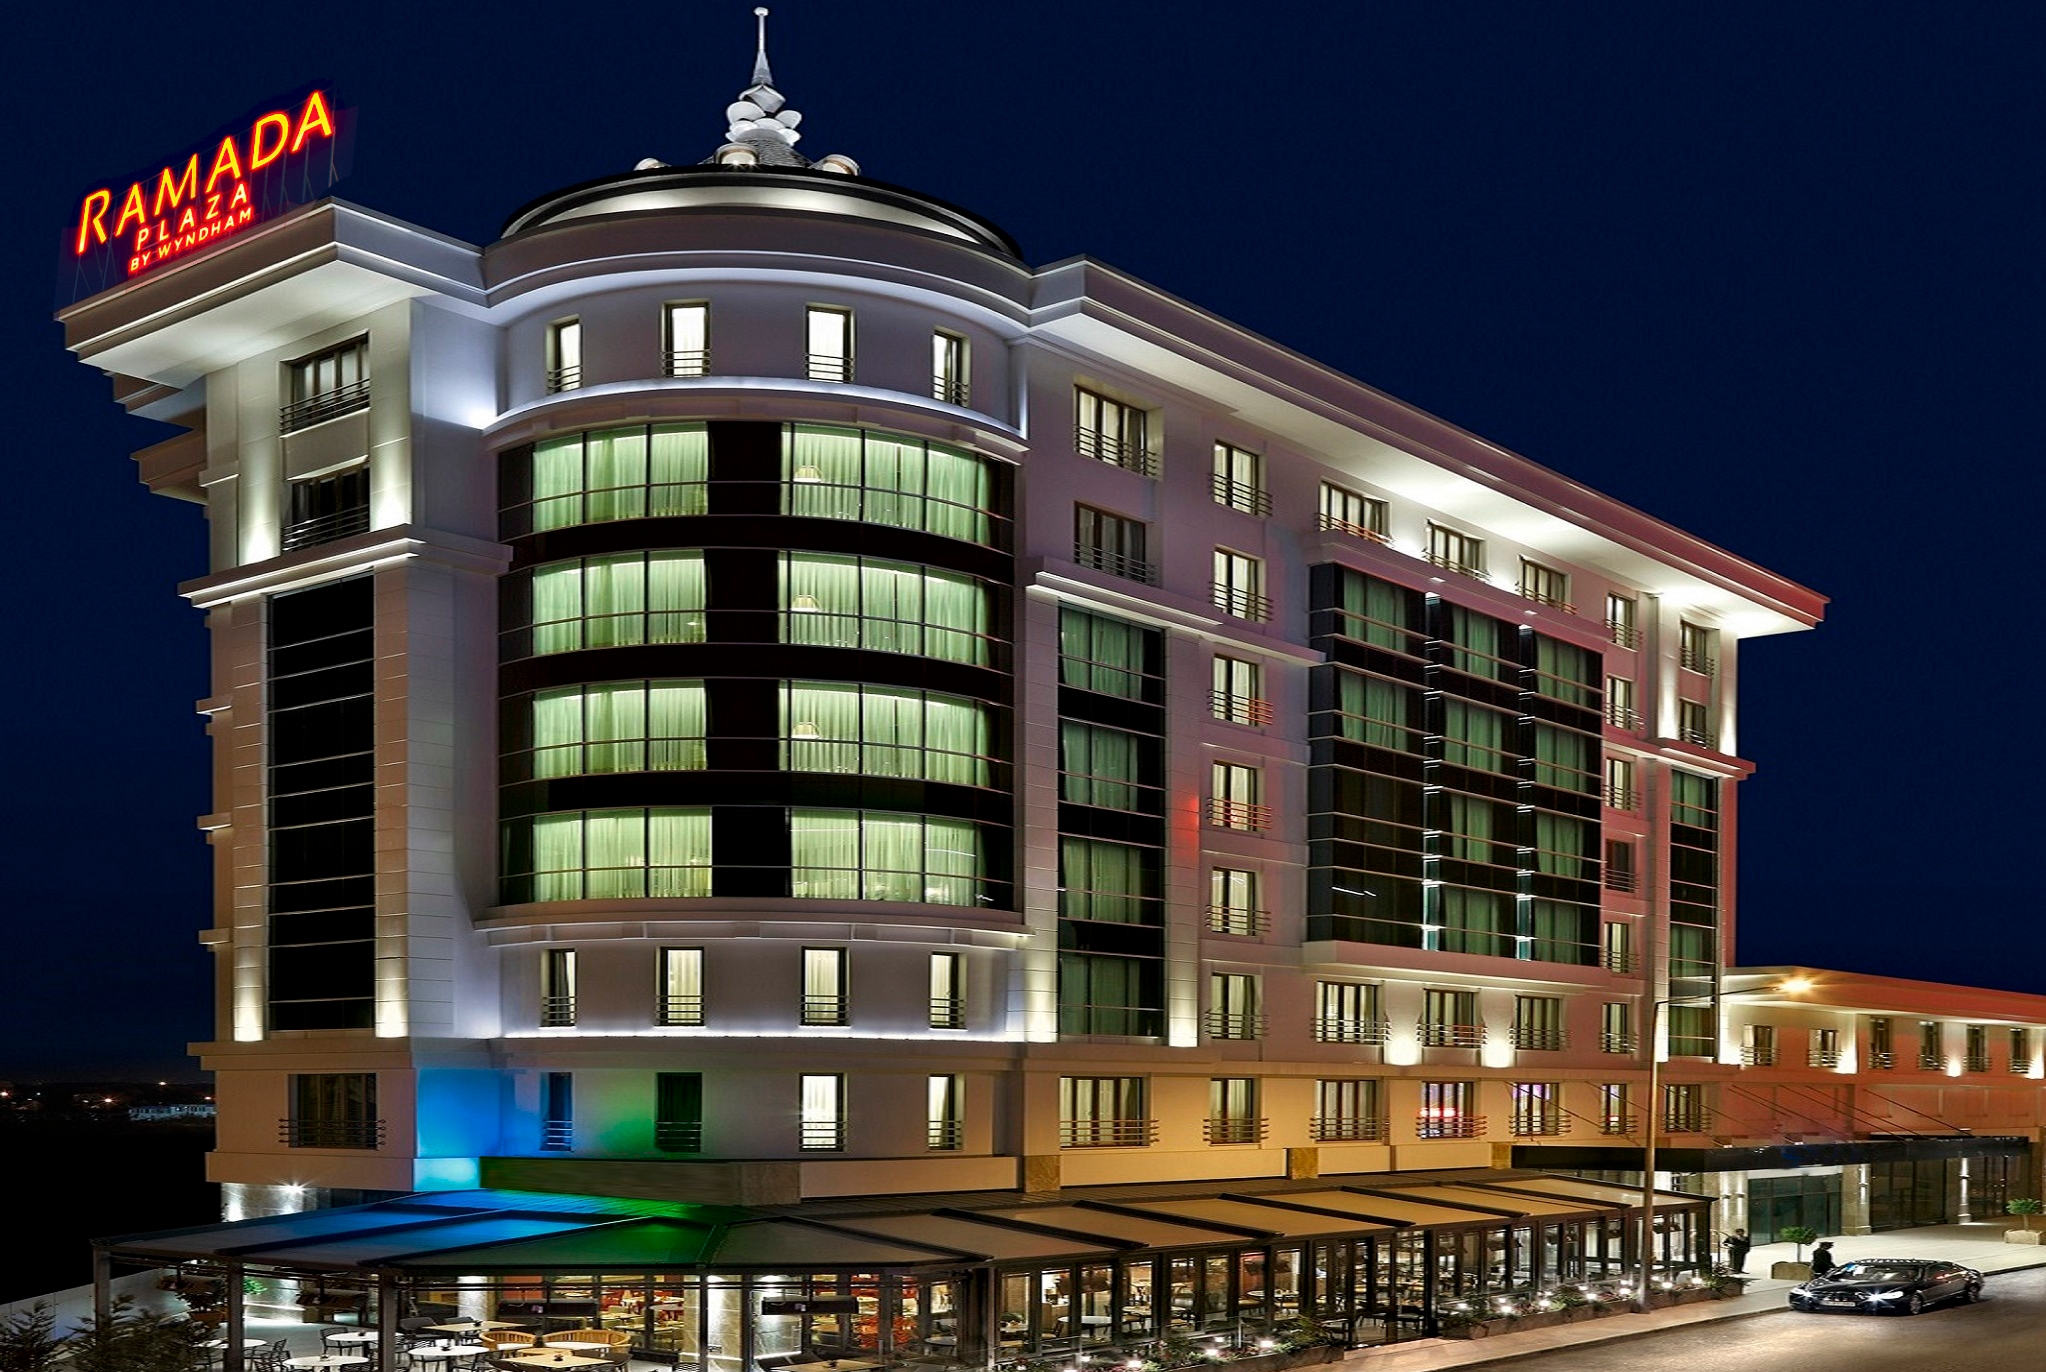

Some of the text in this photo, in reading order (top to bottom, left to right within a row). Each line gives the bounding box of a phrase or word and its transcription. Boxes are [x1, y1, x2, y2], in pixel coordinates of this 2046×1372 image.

[76, 90, 333, 254] RAMADA
[129, 206, 253, 272] BY WYNDHAM
[135, 182, 249, 252] PLAZA
